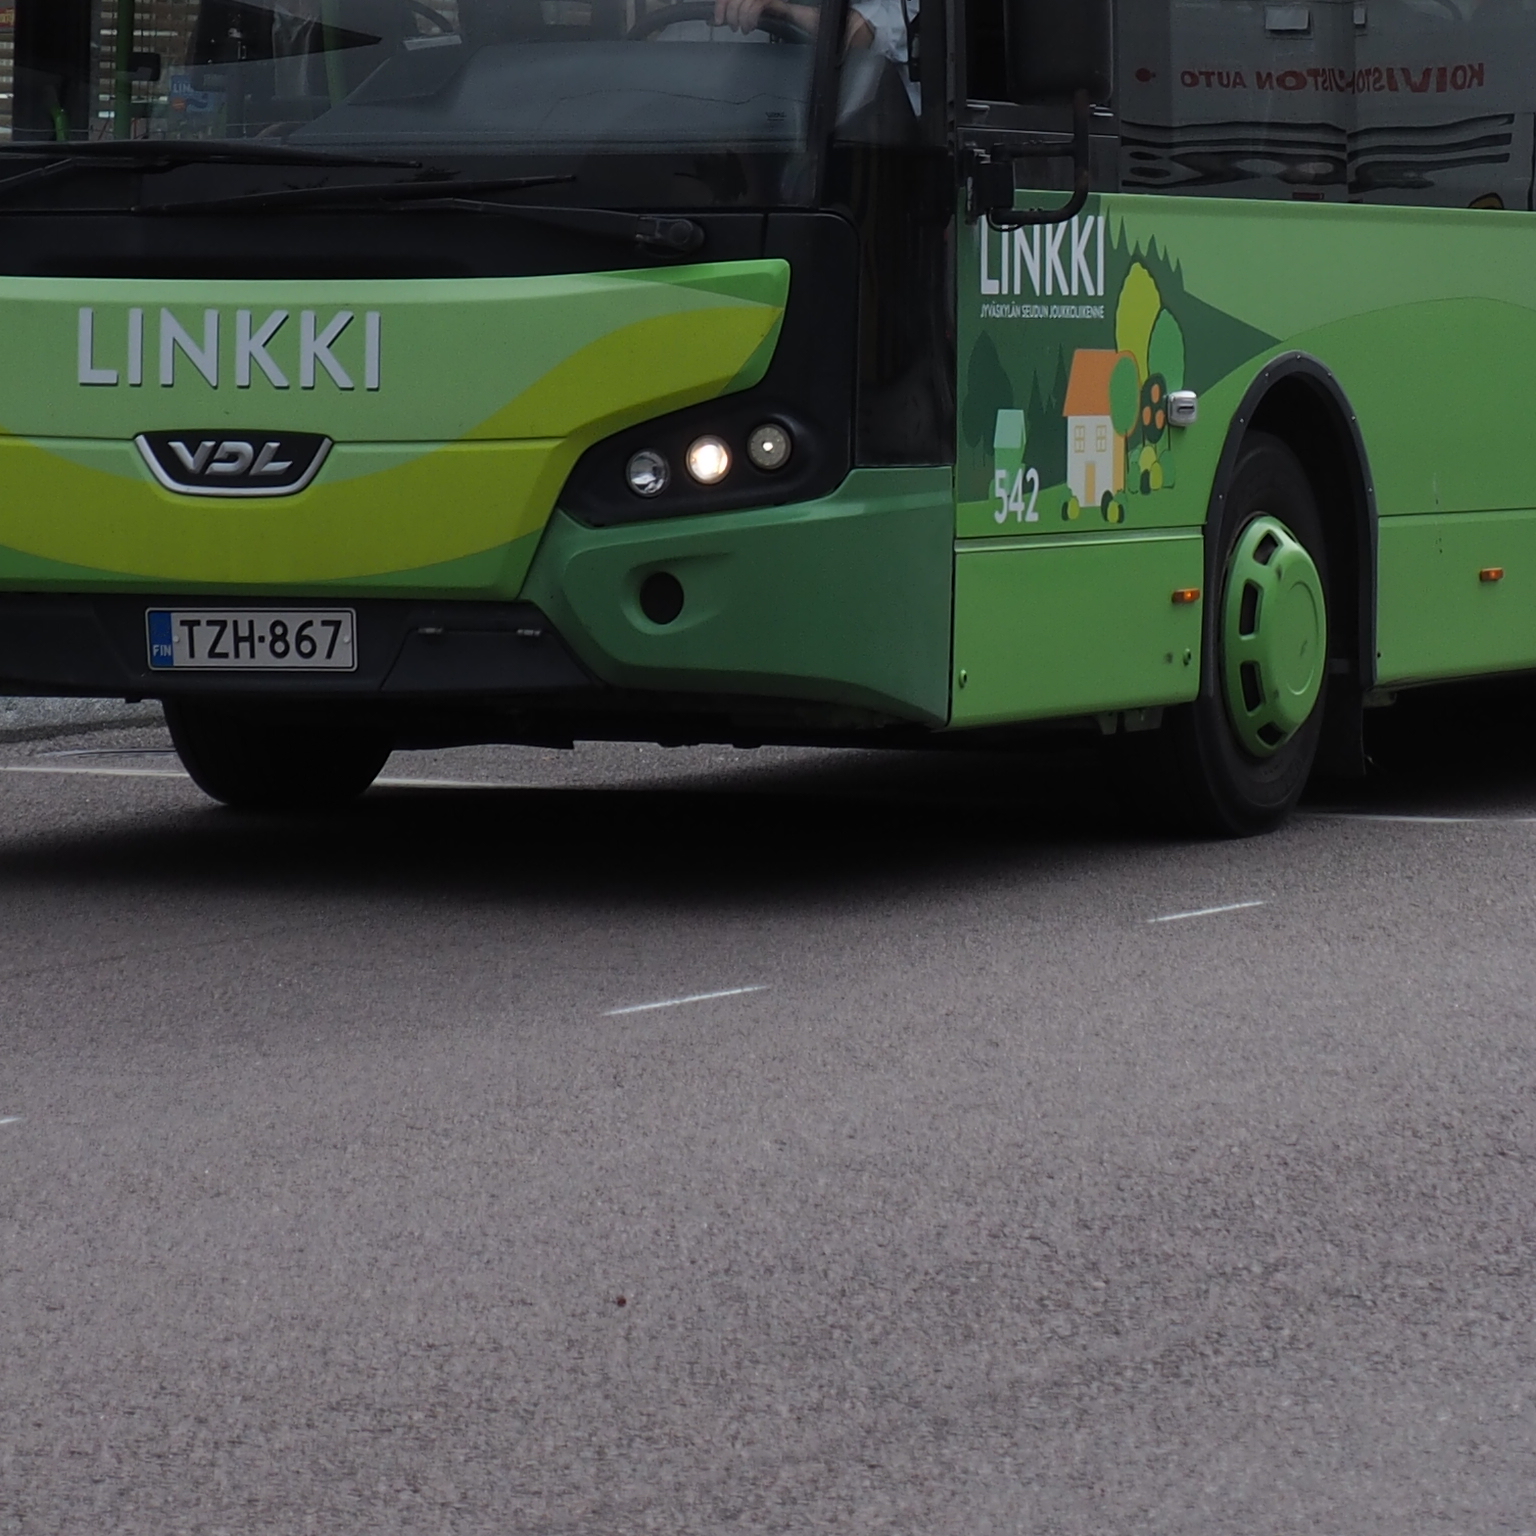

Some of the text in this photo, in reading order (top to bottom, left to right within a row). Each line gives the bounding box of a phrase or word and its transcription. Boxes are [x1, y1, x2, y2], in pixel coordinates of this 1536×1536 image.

[981, 215, 1105, 296] LINKKI
[77, 307, 381, 392] LINKKI
[166, 438, 293, 476] VDL
[994, 467, 1040, 524] 542
[151, 619, 342, 660] FIN TZH-867
